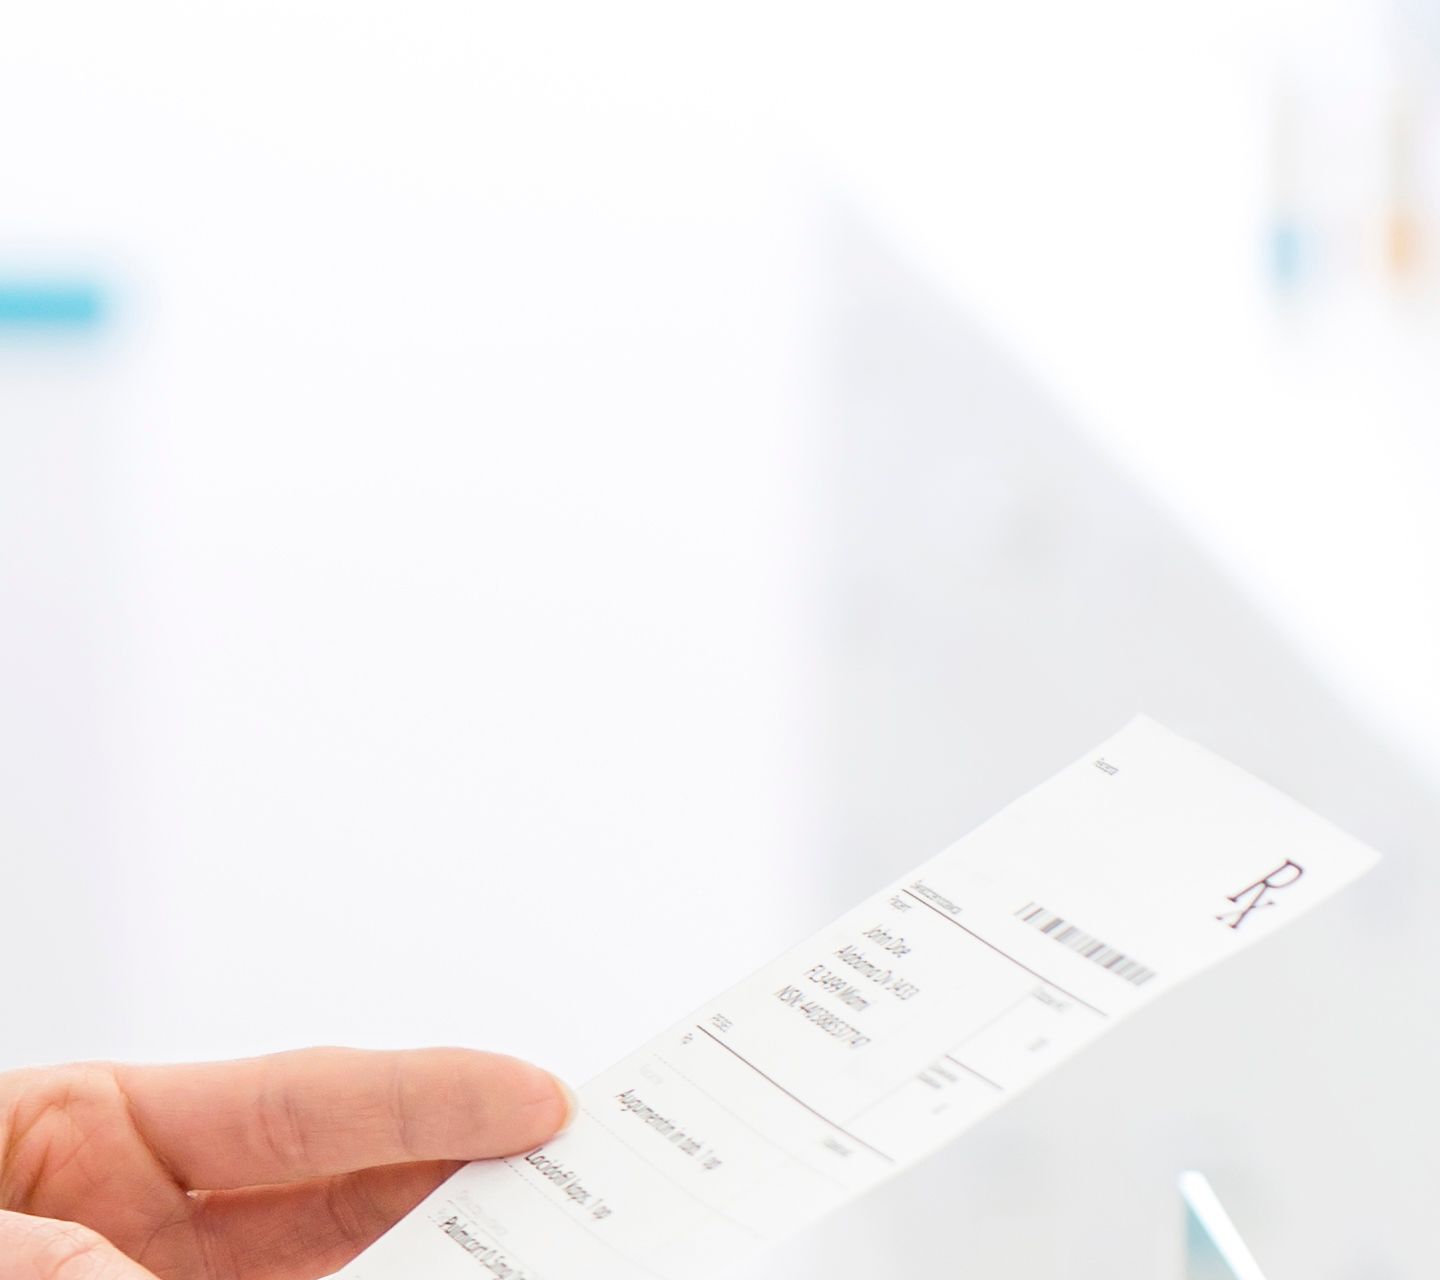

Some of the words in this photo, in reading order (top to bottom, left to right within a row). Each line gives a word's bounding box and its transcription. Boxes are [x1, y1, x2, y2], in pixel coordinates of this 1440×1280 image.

[862, 925, 892, 945] John
[885, 938, 911, 958] Doe
[835, 945, 881, 978] Alabama
